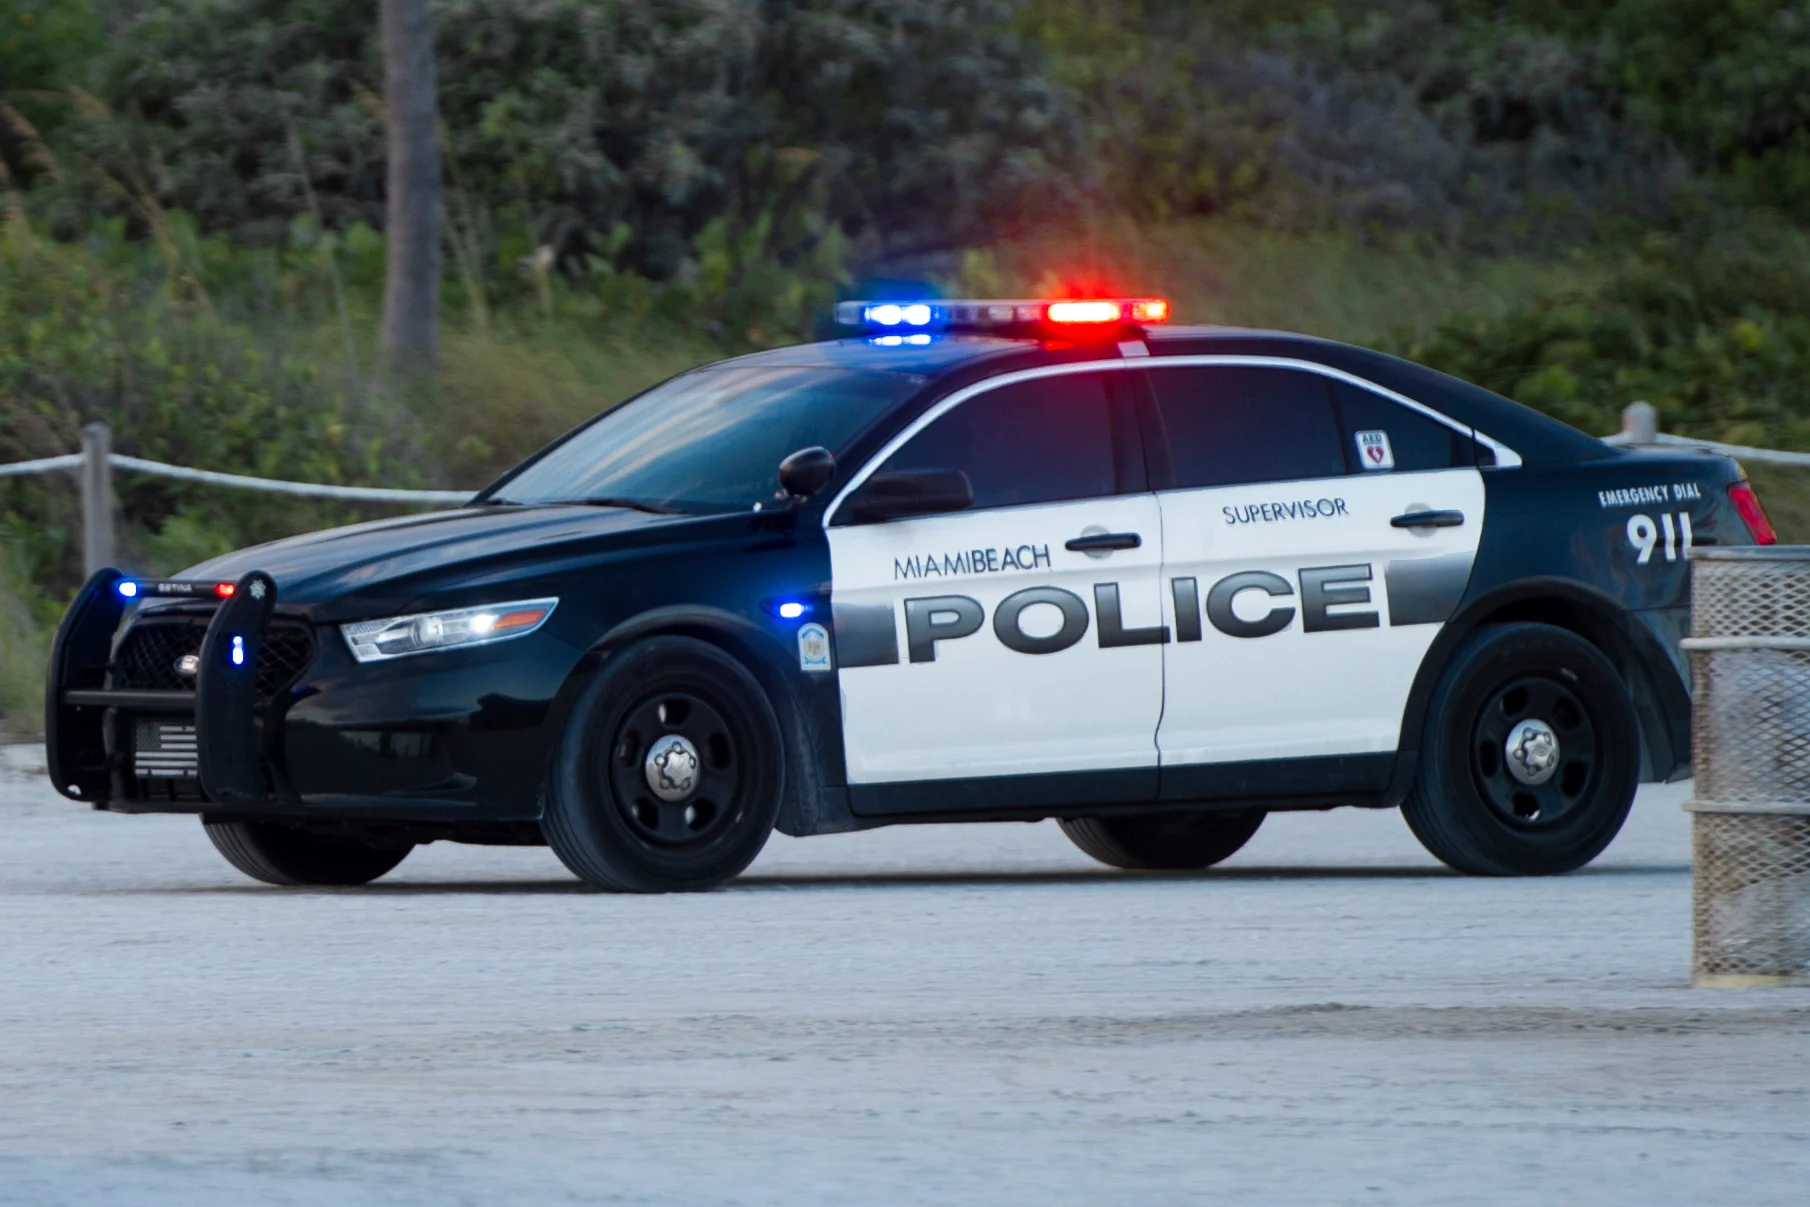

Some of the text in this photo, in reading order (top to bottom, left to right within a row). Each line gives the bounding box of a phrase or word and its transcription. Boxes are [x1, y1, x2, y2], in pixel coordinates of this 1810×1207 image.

[1362, 433, 1383, 443] AED
[1598, 482, 1701, 508] EMERGENCY DIAL
[1223, 498, 1349, 525] SUPERVISOR
[1626, 511, 1693, 565] 911
[903, 562, 1380, 664] POLICE
